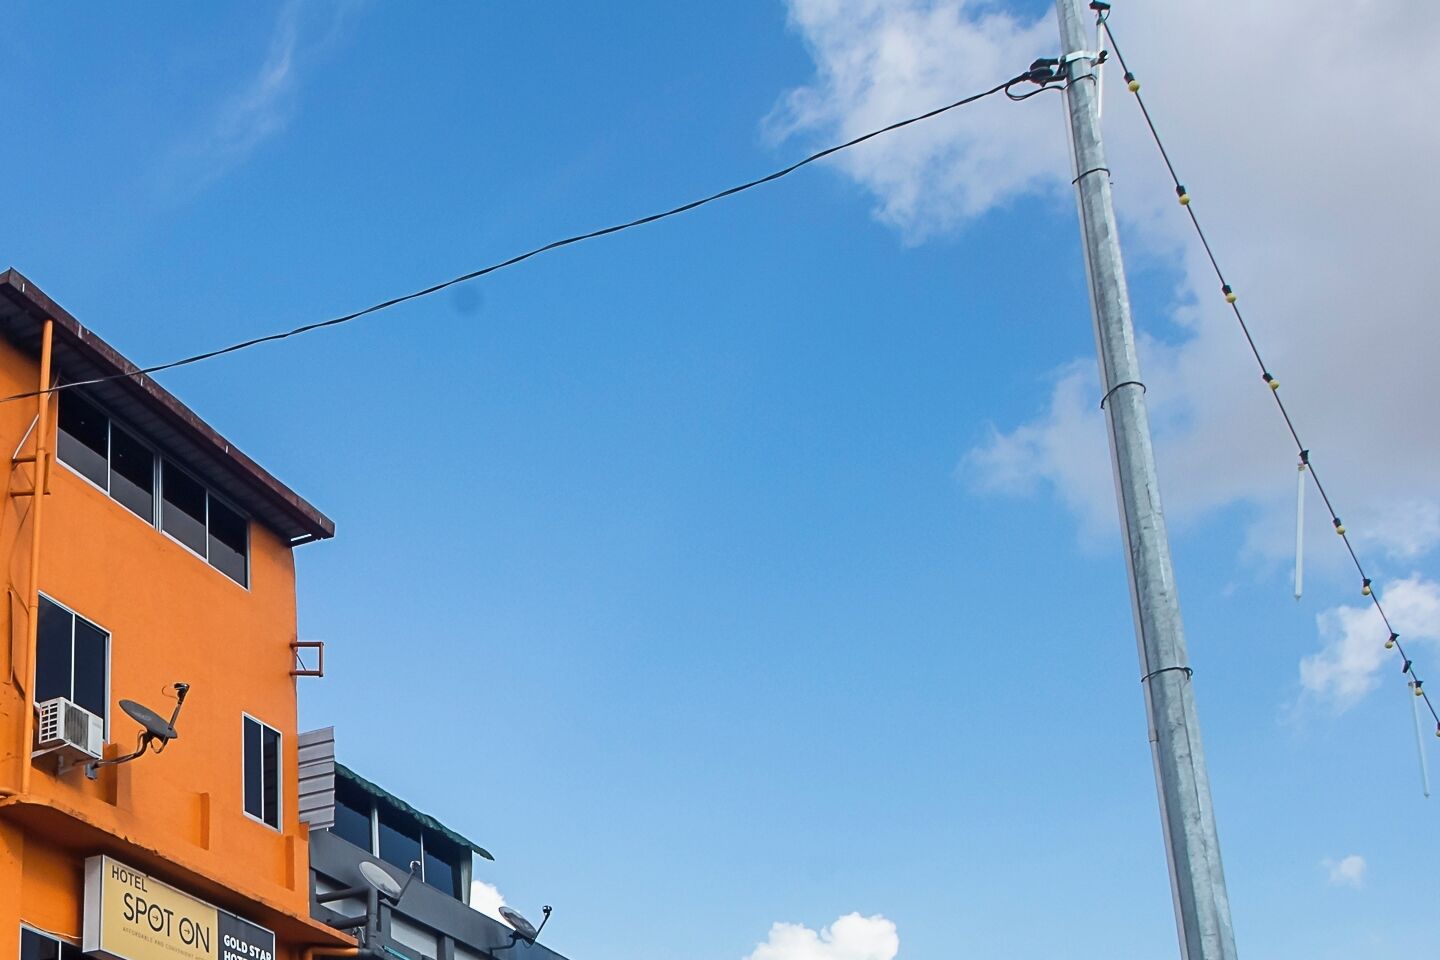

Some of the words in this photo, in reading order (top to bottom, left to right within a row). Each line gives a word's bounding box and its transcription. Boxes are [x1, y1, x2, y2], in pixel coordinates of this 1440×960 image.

[111, 864, 148, 893] HOTEL
[123, 892, 174, 937] SPOT
[179, 917, 210, 953] ON
[223, 934, 249, 955] GOLD
